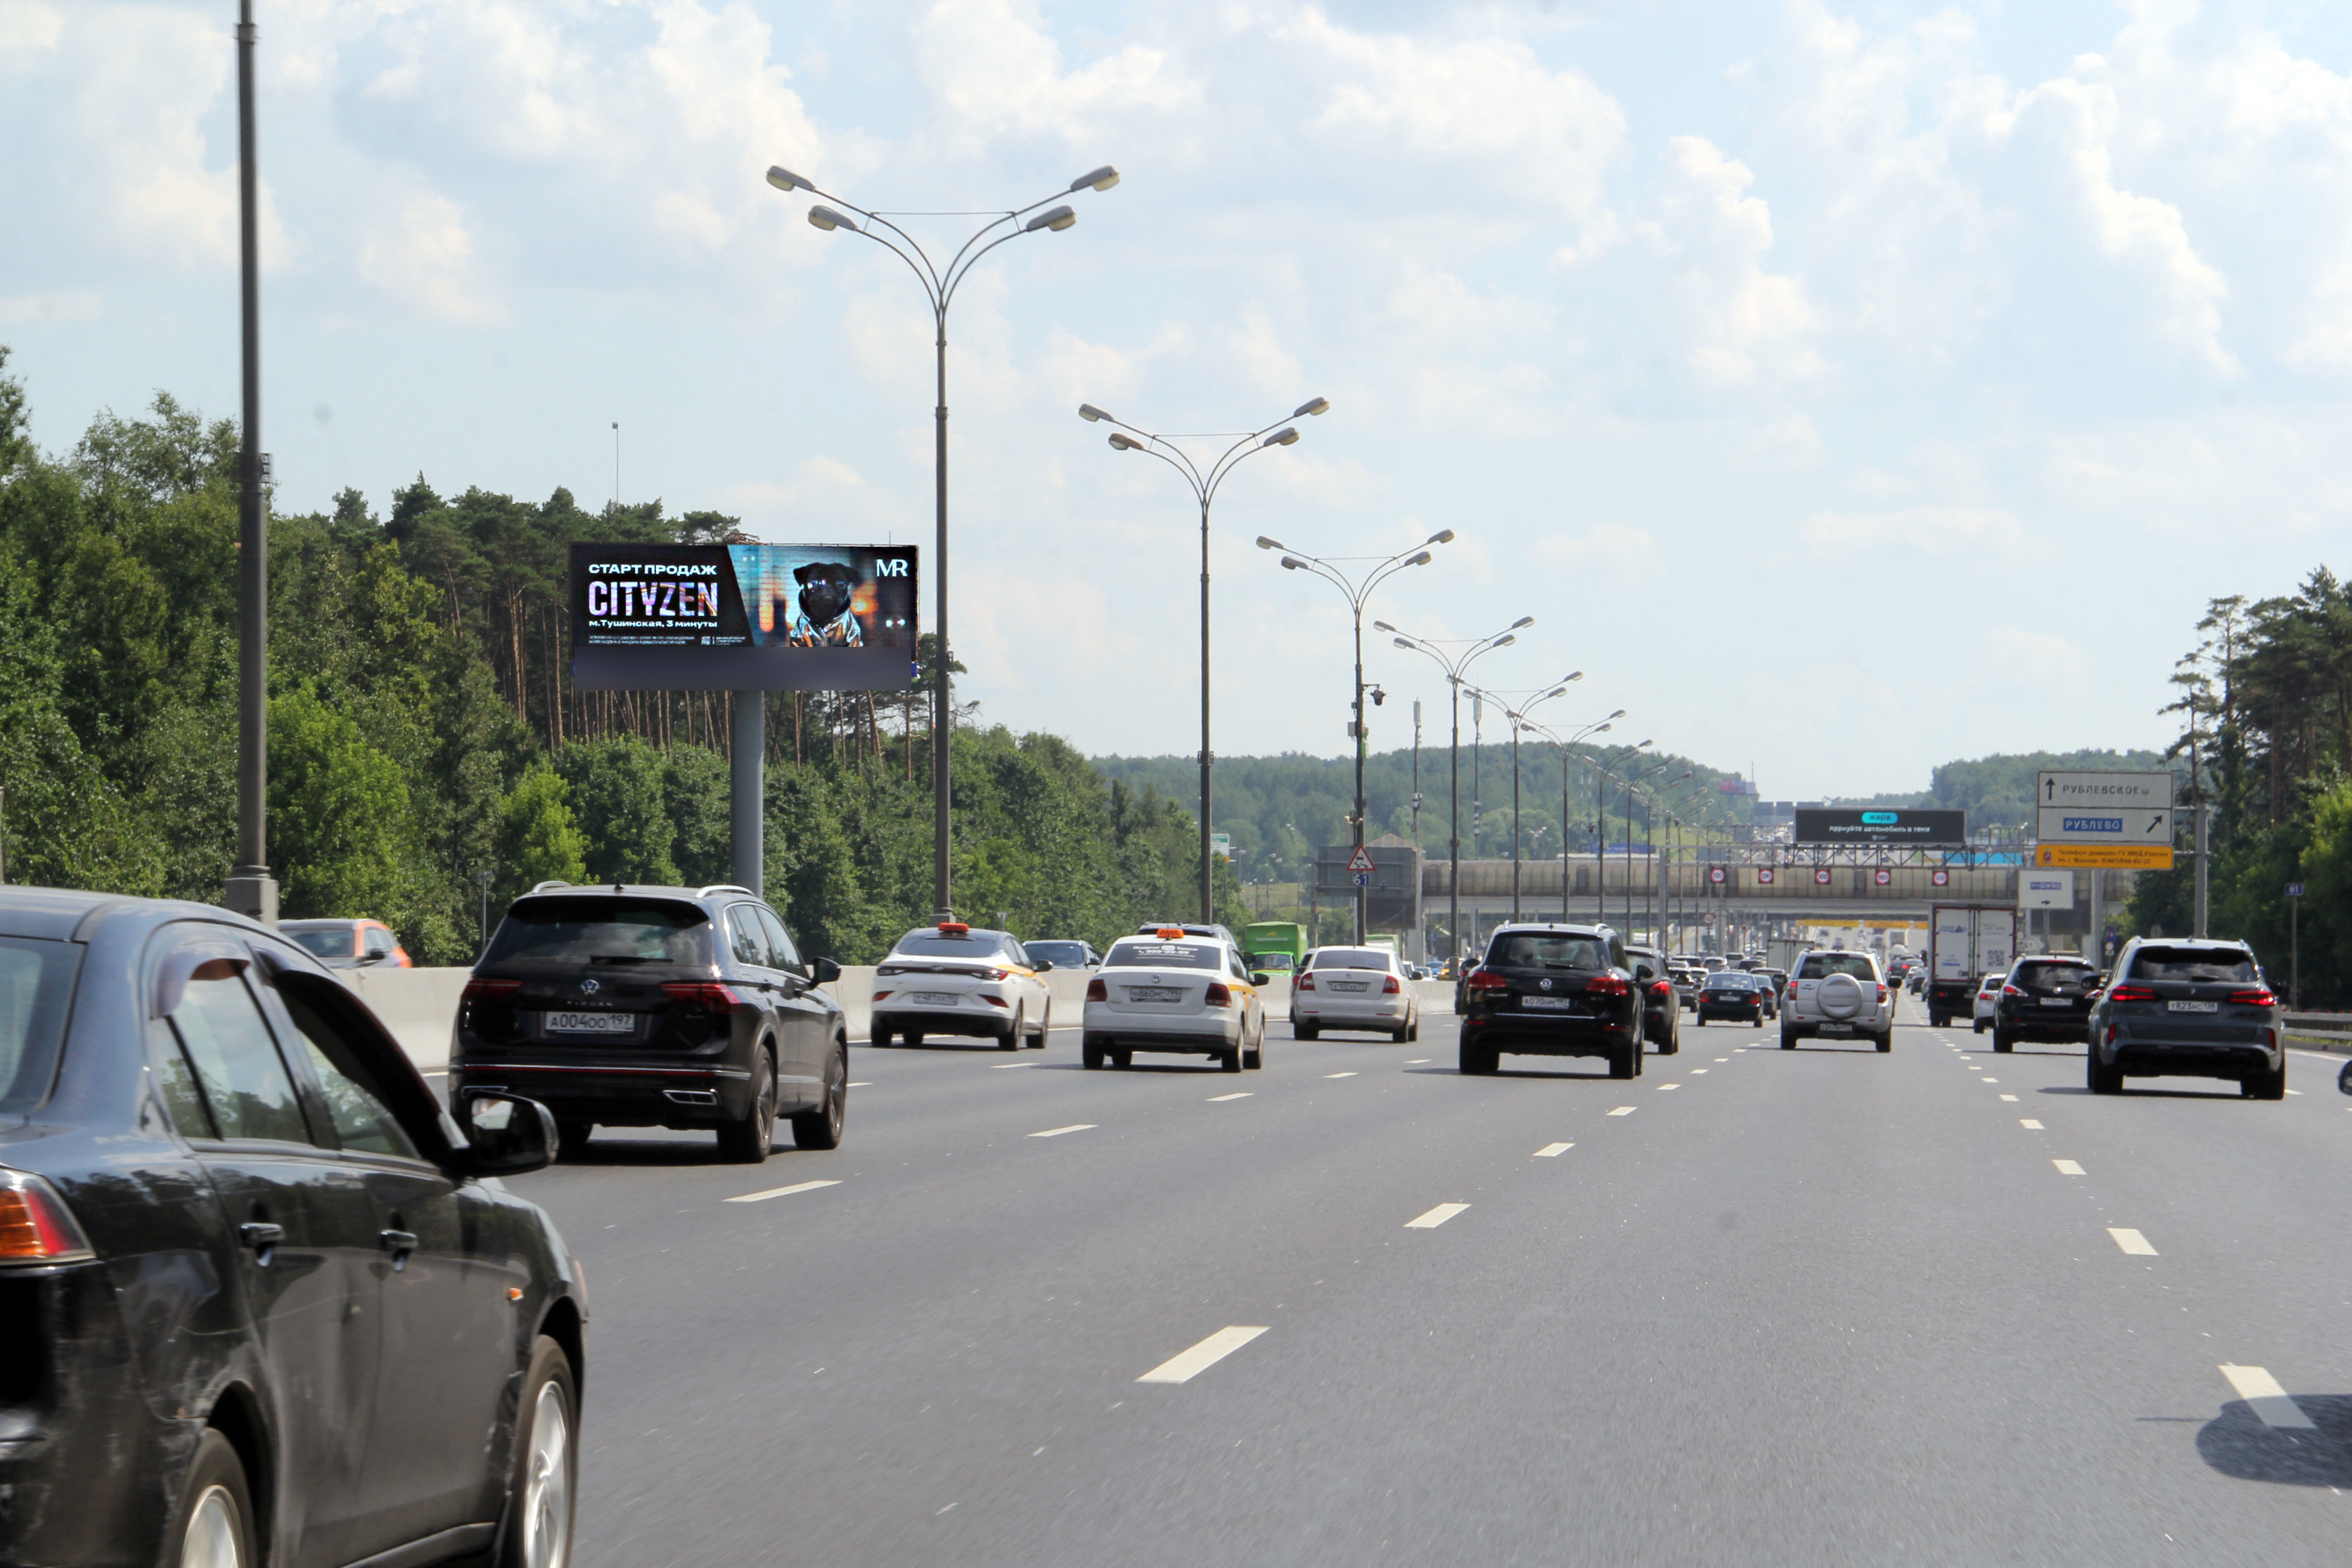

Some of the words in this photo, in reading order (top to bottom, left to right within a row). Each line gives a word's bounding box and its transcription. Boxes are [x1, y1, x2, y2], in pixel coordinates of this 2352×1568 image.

[588, 564, 641, 575] СТАРТ
[644, 565, 717, 575] ПРОДАЖ
[876, 558, 908, 577] MR
[588, 581, 718, 617] CITYZEN
[2063, 785, 2139, 795] РУБЛЕВСКОЕ
[2065, 820, 2121, 829] РУБЛЕВО
[1354, 875, 1367, 885] 61
[550, 1013, 607, 1029] А004ОО
[609, 1015, 630, 1025] 197
